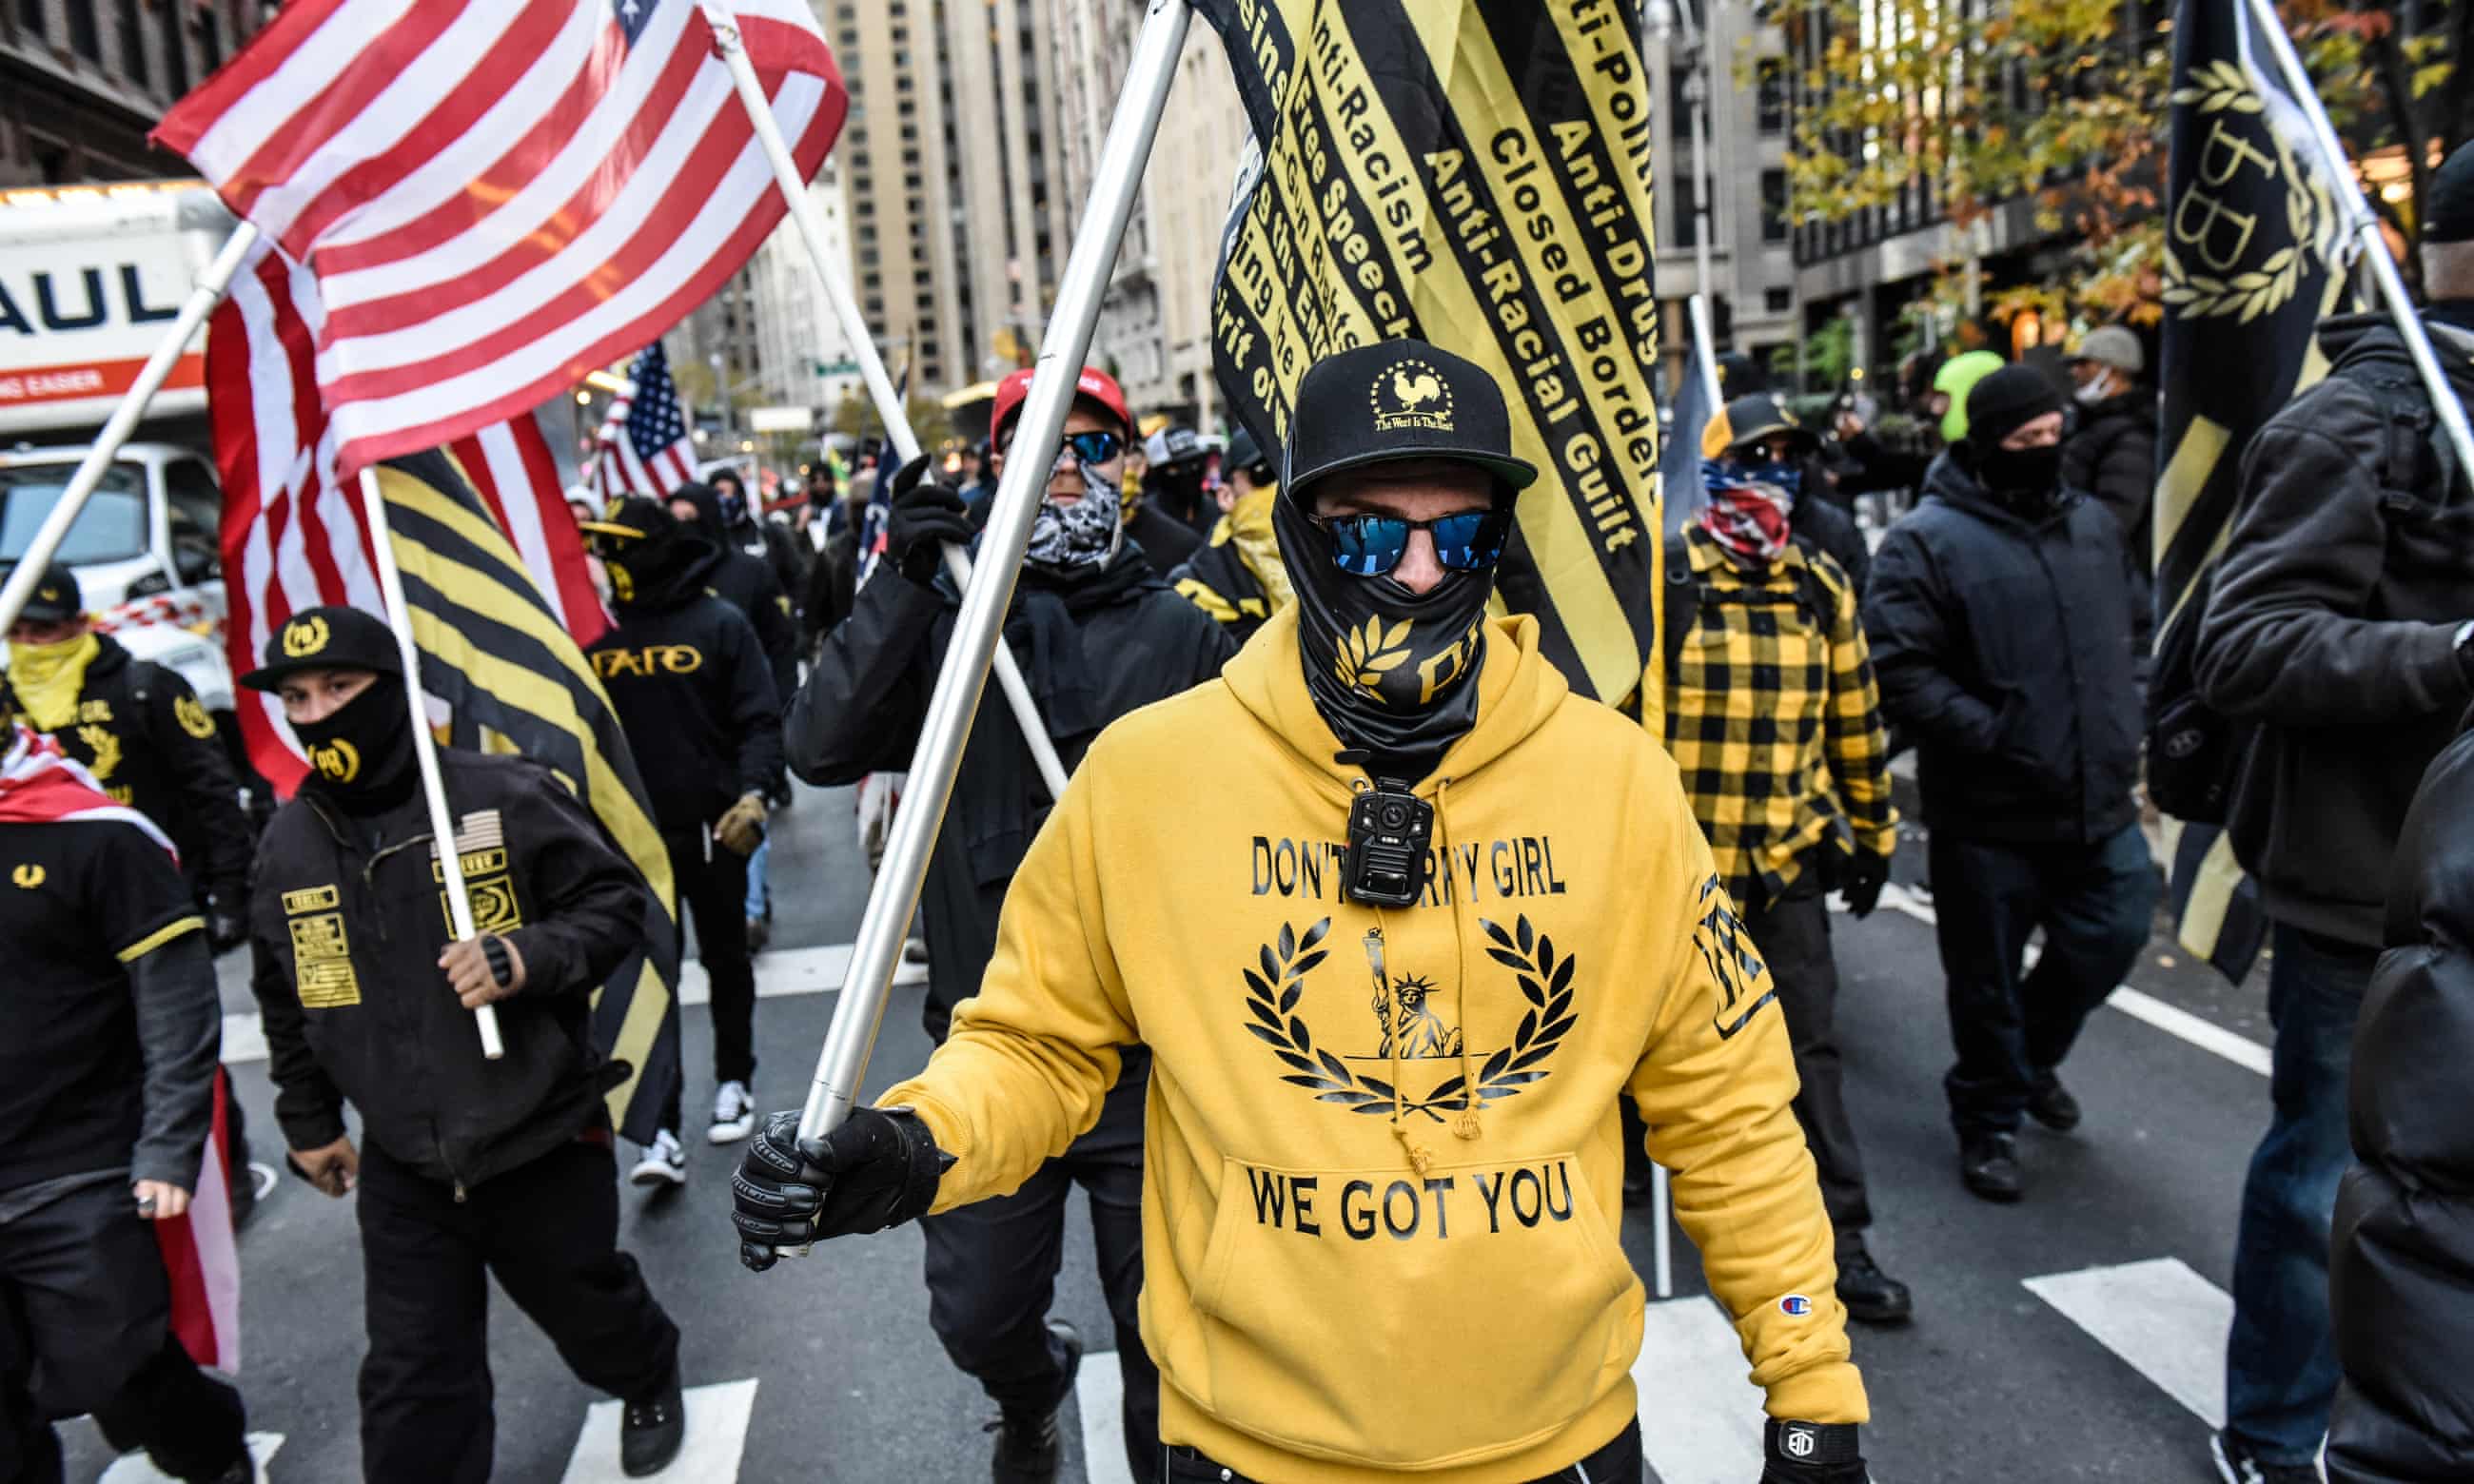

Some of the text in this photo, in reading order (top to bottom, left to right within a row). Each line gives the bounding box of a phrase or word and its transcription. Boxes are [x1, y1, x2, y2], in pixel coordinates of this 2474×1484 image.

[1572, 0, 1652, 194] ti-Poli
[1323, 178, 1412, 341] Speech
[1490, 127, 1658, 506] Closed Border
[1424, 146, 1638, 555] Anti-Racial Guilt
[1252, 836, 1565, 907] DON'T RRY GIRL
[1247, 1162, 1573, 1240] WE GOT YOU
